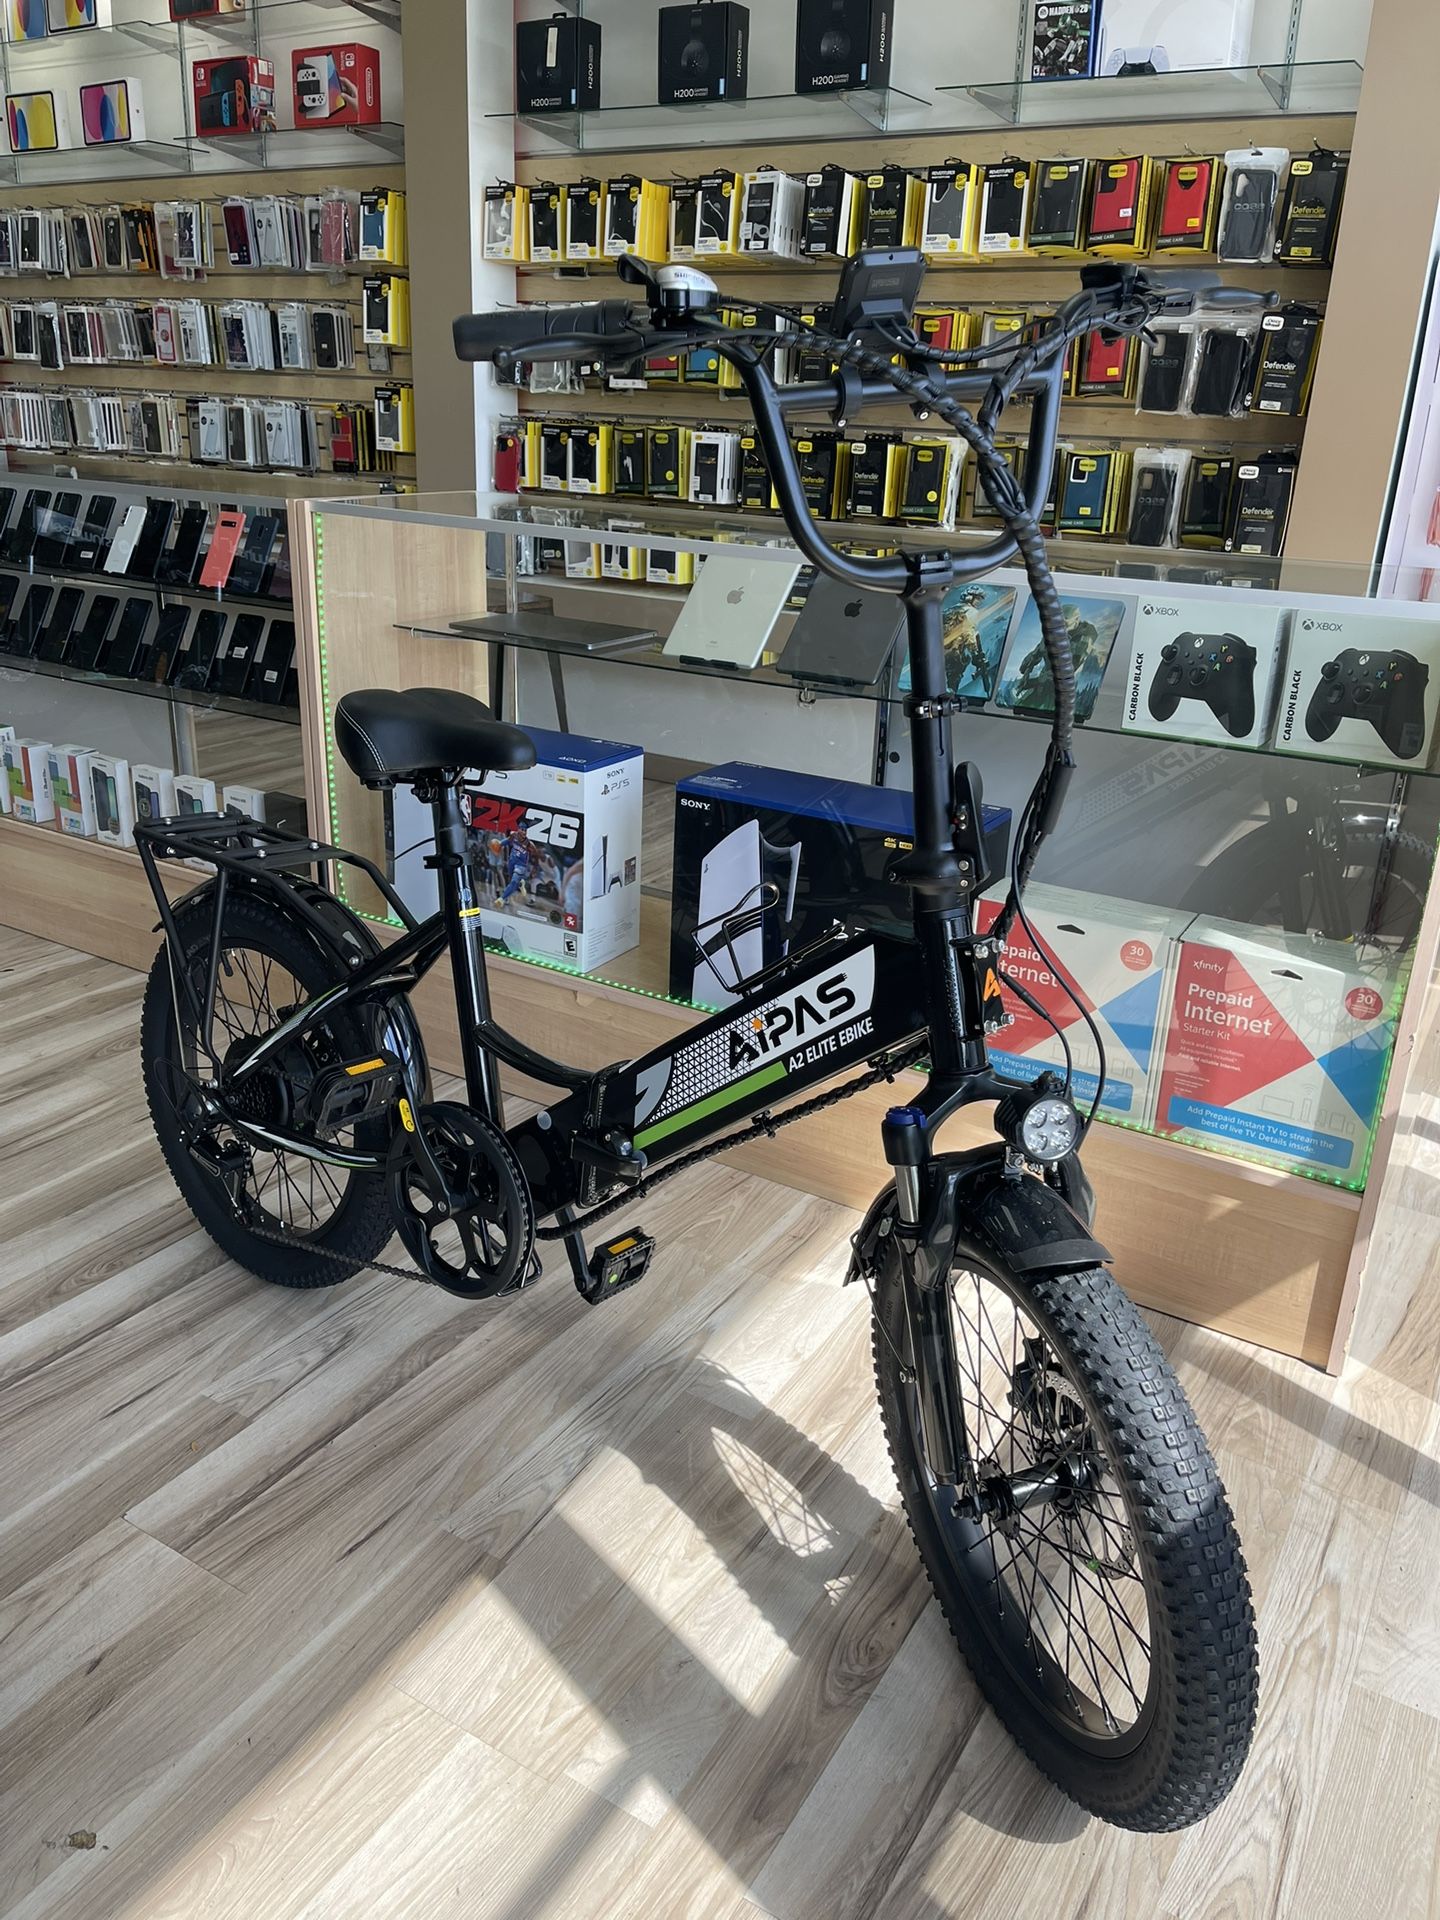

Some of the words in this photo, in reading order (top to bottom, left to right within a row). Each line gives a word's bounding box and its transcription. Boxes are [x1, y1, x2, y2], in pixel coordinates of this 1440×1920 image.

[1049, 6, 1074, 16] MADDEN
[812, 75, 834, 85] H200
[674, 89, 694, 98] H200
[531, 98, 549, 106] H200
[810, 206, 834, 214] Defender
[870, 207, 897, 216] Defender
[1292, 206, 1325, 214] Defender
[1263, 361, 1297, 370] Defender
[801, 476, 825, 484] Defender
[1242, 507, 1274, 516] Defender
[1155, 607, 1179, 616] XBOX
[1315, 622, 1342, 632] XBOX
[1129, 683, 1140, 721] CARBON
[1135, 653, 1144, 681] BLACK
[1283, 702, 1295, 741] CARBON
[1291, 670, 1302, 699] BLACK
[607, 768, 625, 778] SONY
[610, 779, 630, 791] PS5
[681, 798, 710, 810] SONY
[566, 941, 575, 951] E
[1130, 945, 1144, 956] 30
[1193, 960, 1224, 974] xfinity
[1188, 983, 1253, 1008] Prepaid
[1356, 994, 1374, 1005] 30
[1185, 1000, 1272, 1035] Internet
[1184, 1023, 1214, 1036] Starter
[1217, 1031, 1230, 1040] Kit
[789, 1055, 804, 1072] A2
[806, 1037, 836, 1064] ELITE
[839, 1017, 874, 1046] EBIKE
[989, 1054, 1002, 1063] Add
[1004, 1057, 1030, 1070] Prepaid
[1001, 1065, 1016, 1075] best
[1187, 1105, 1203, 1116] Add
[1205, 1108, 1236, 1124] Prepaid
[1237, 1117, 1265, 1131] Instant
[1267, 1125, 1278, 1134] TV
[1289, 1133, 1319, 1145] stream
[1320, 1139, 1334, 1150] the
[1201, 1118, 1218, 1129] best
[1220, 1122, 1228, 1130] of
[1229, 1125, 1243, 1135] live
[1245, 1130, 1256, 1138] TV.
[1258, 1133, 1287, 1146] Details
[1288, 1141, 1314, 1154] inside.
